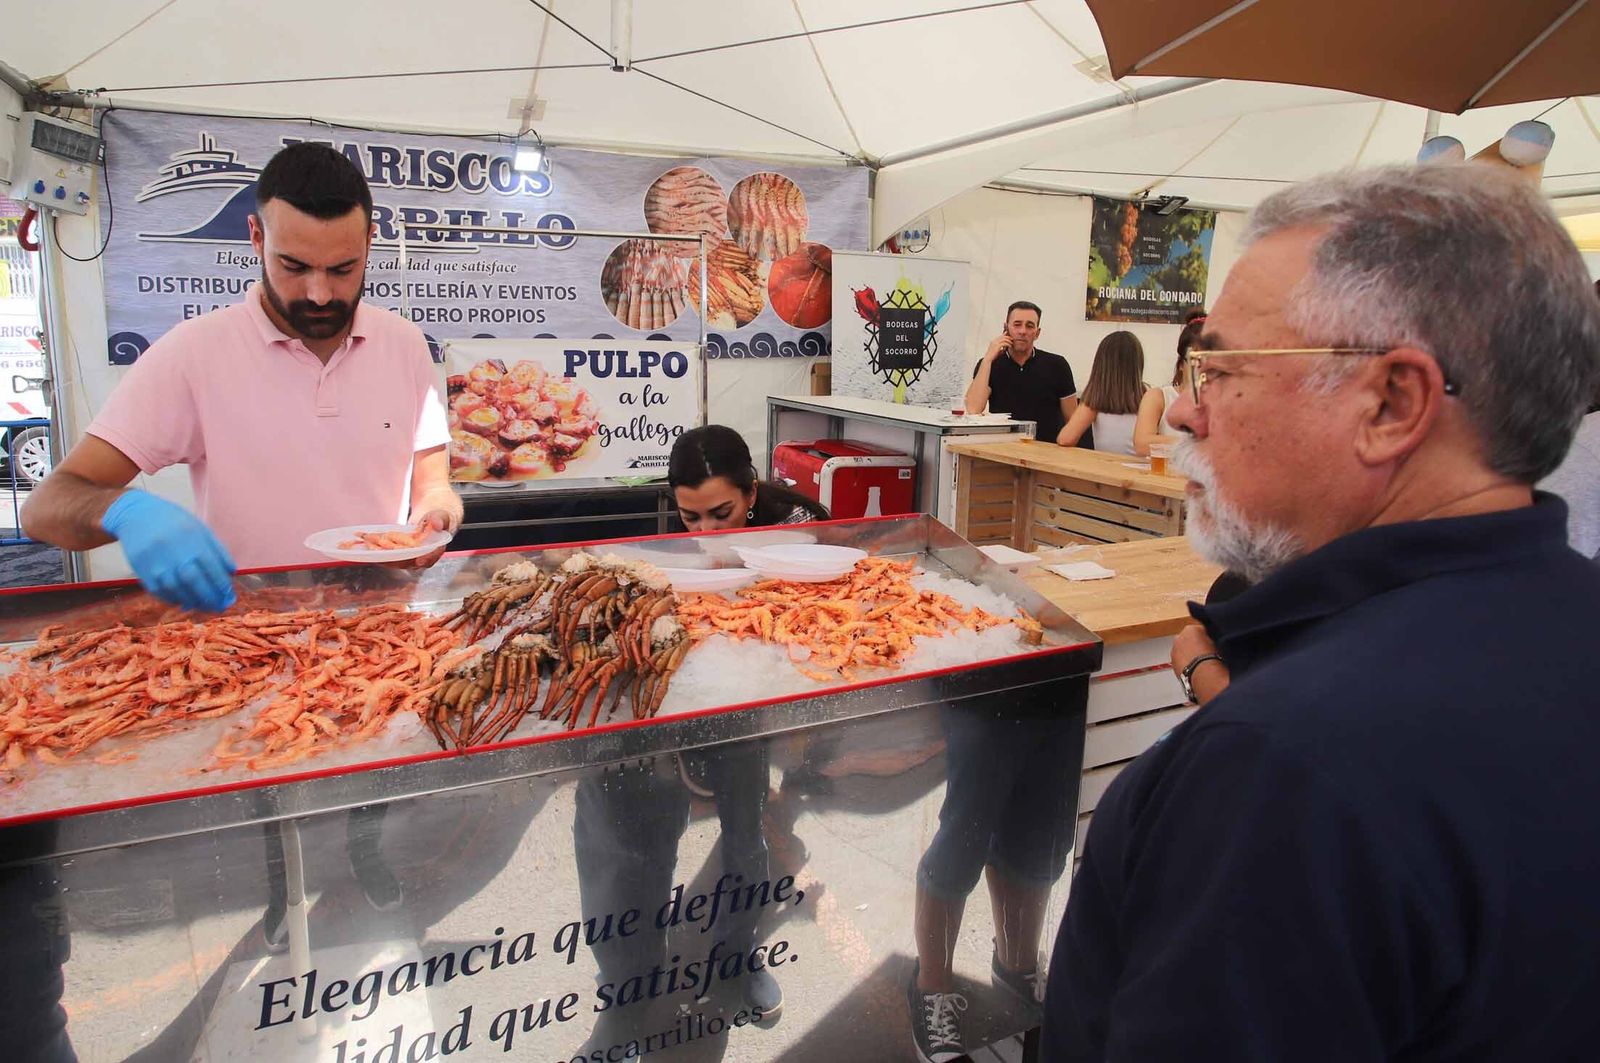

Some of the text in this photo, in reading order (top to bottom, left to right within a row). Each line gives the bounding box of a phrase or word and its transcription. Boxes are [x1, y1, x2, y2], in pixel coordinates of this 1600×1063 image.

[281, 138, 552, 196] ARISCOS
[372, 204, 577, 249] RRILLO
[216, 251, 263, 270] Elega
[434, 262, 458, 275] que
[461, 260, 517, 276] satisface
[138, 276, 262, 295] DISTRIBUC
[482, 285, 493, 299] Y
[498, 285, 577, 301] EVENTOS
[1099, 286, 1203, 304] ROCIANA DEL CONDADO
[468, 308, 546, 323] PROPIOS
[0, 326, 39, 338] RISCO
[563, 349, 689, 379] PULPO
[619, 384, 669, 407] a la
[597, 414, 685, 448] gallega
[254, 873, 805, 1031] Elegancia que define,
[489, 992, 579, 1053] que
[593, 940, 799, 1013] satisface.
